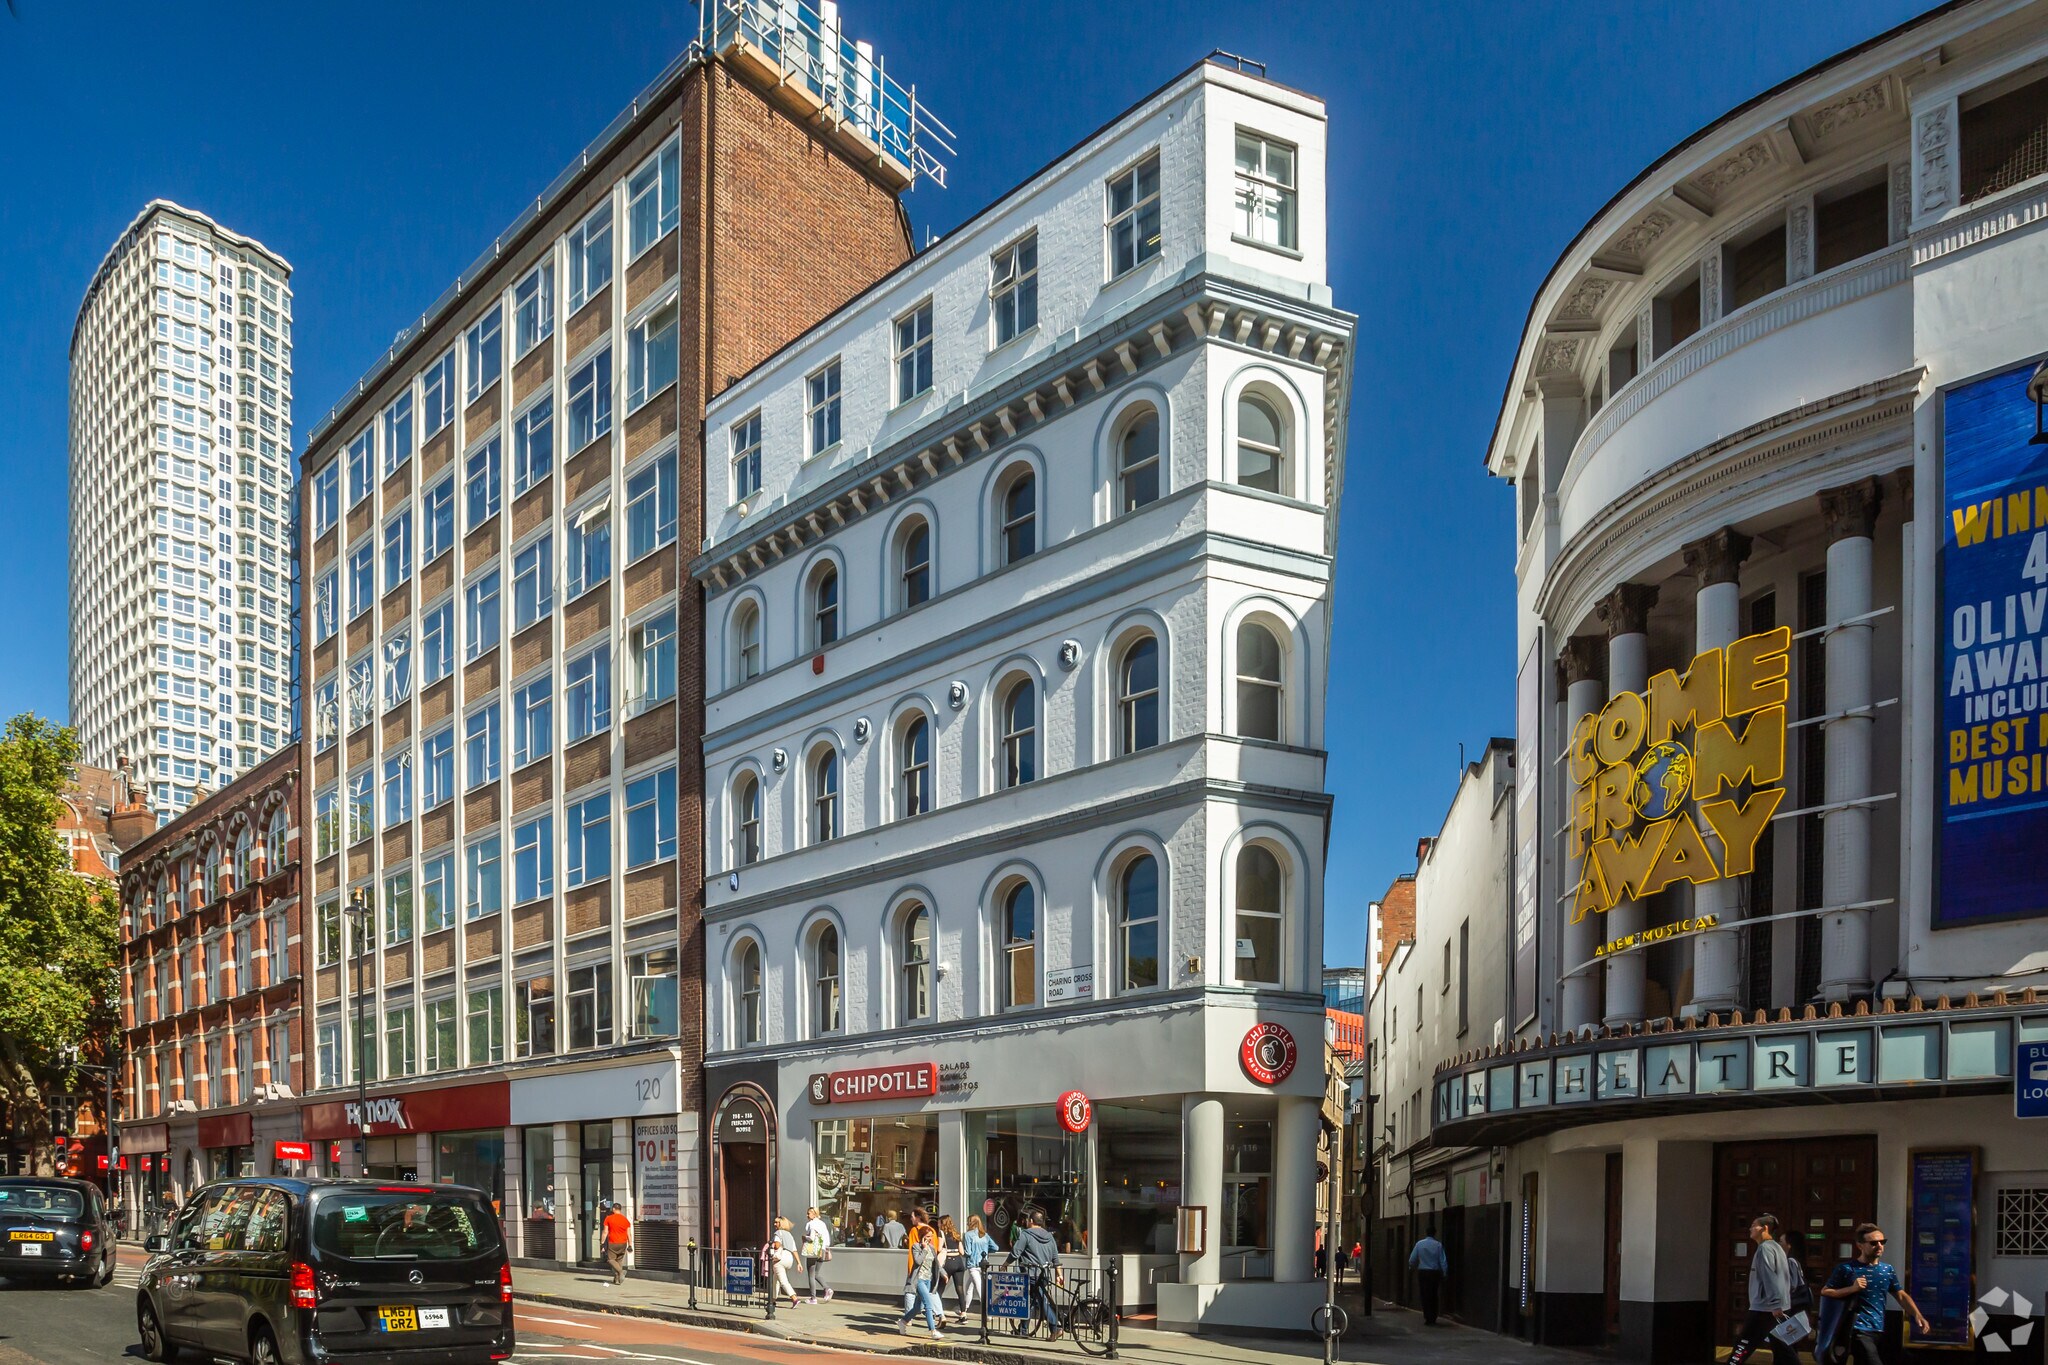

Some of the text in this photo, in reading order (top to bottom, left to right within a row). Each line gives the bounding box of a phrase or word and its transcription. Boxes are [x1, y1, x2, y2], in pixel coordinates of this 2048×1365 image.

[2022, 530, 2048, 585] 4
[1952, 587, 2048, 650] OLIV
[1569, 625, 1792, 785] COME
[1949, 716, 2030, 764] BEST
[1569, 704, 1786, 860] FROM
[1569, 787, 1786, 925] AWAY
[1594, 914, 1717, 957] A NEW MUSICAL
[1048, 973, 1093, 987] CHARING CROSS
[1078, 984, 1091, 993] WC2
[1048, 988, 1064, 997] ROAD
[1246, 1025, 1295, 1050] CHIPOTLE
[939, 1061, 970, 1071] SALADS
[939, 1072, 968, 1082] BOWLS
[1247, 1057, 1294, 1080] MEXICAN GRILL
[1528, 1046, 1856, 1098] THEATRE
[635, 1077, 661, 1101] 120
[833, 1069, 929, 1096] CHIPOTLE
[1065, 1092, 1090, 1109] CHIPOTLE
[637, 1125, 659, 1136] OFFICES
[638, 1139, 678, 1162] TO LE
[382, 1307, 412, 1317] LM67
[390, 1318, 414, 1329] GRZ
